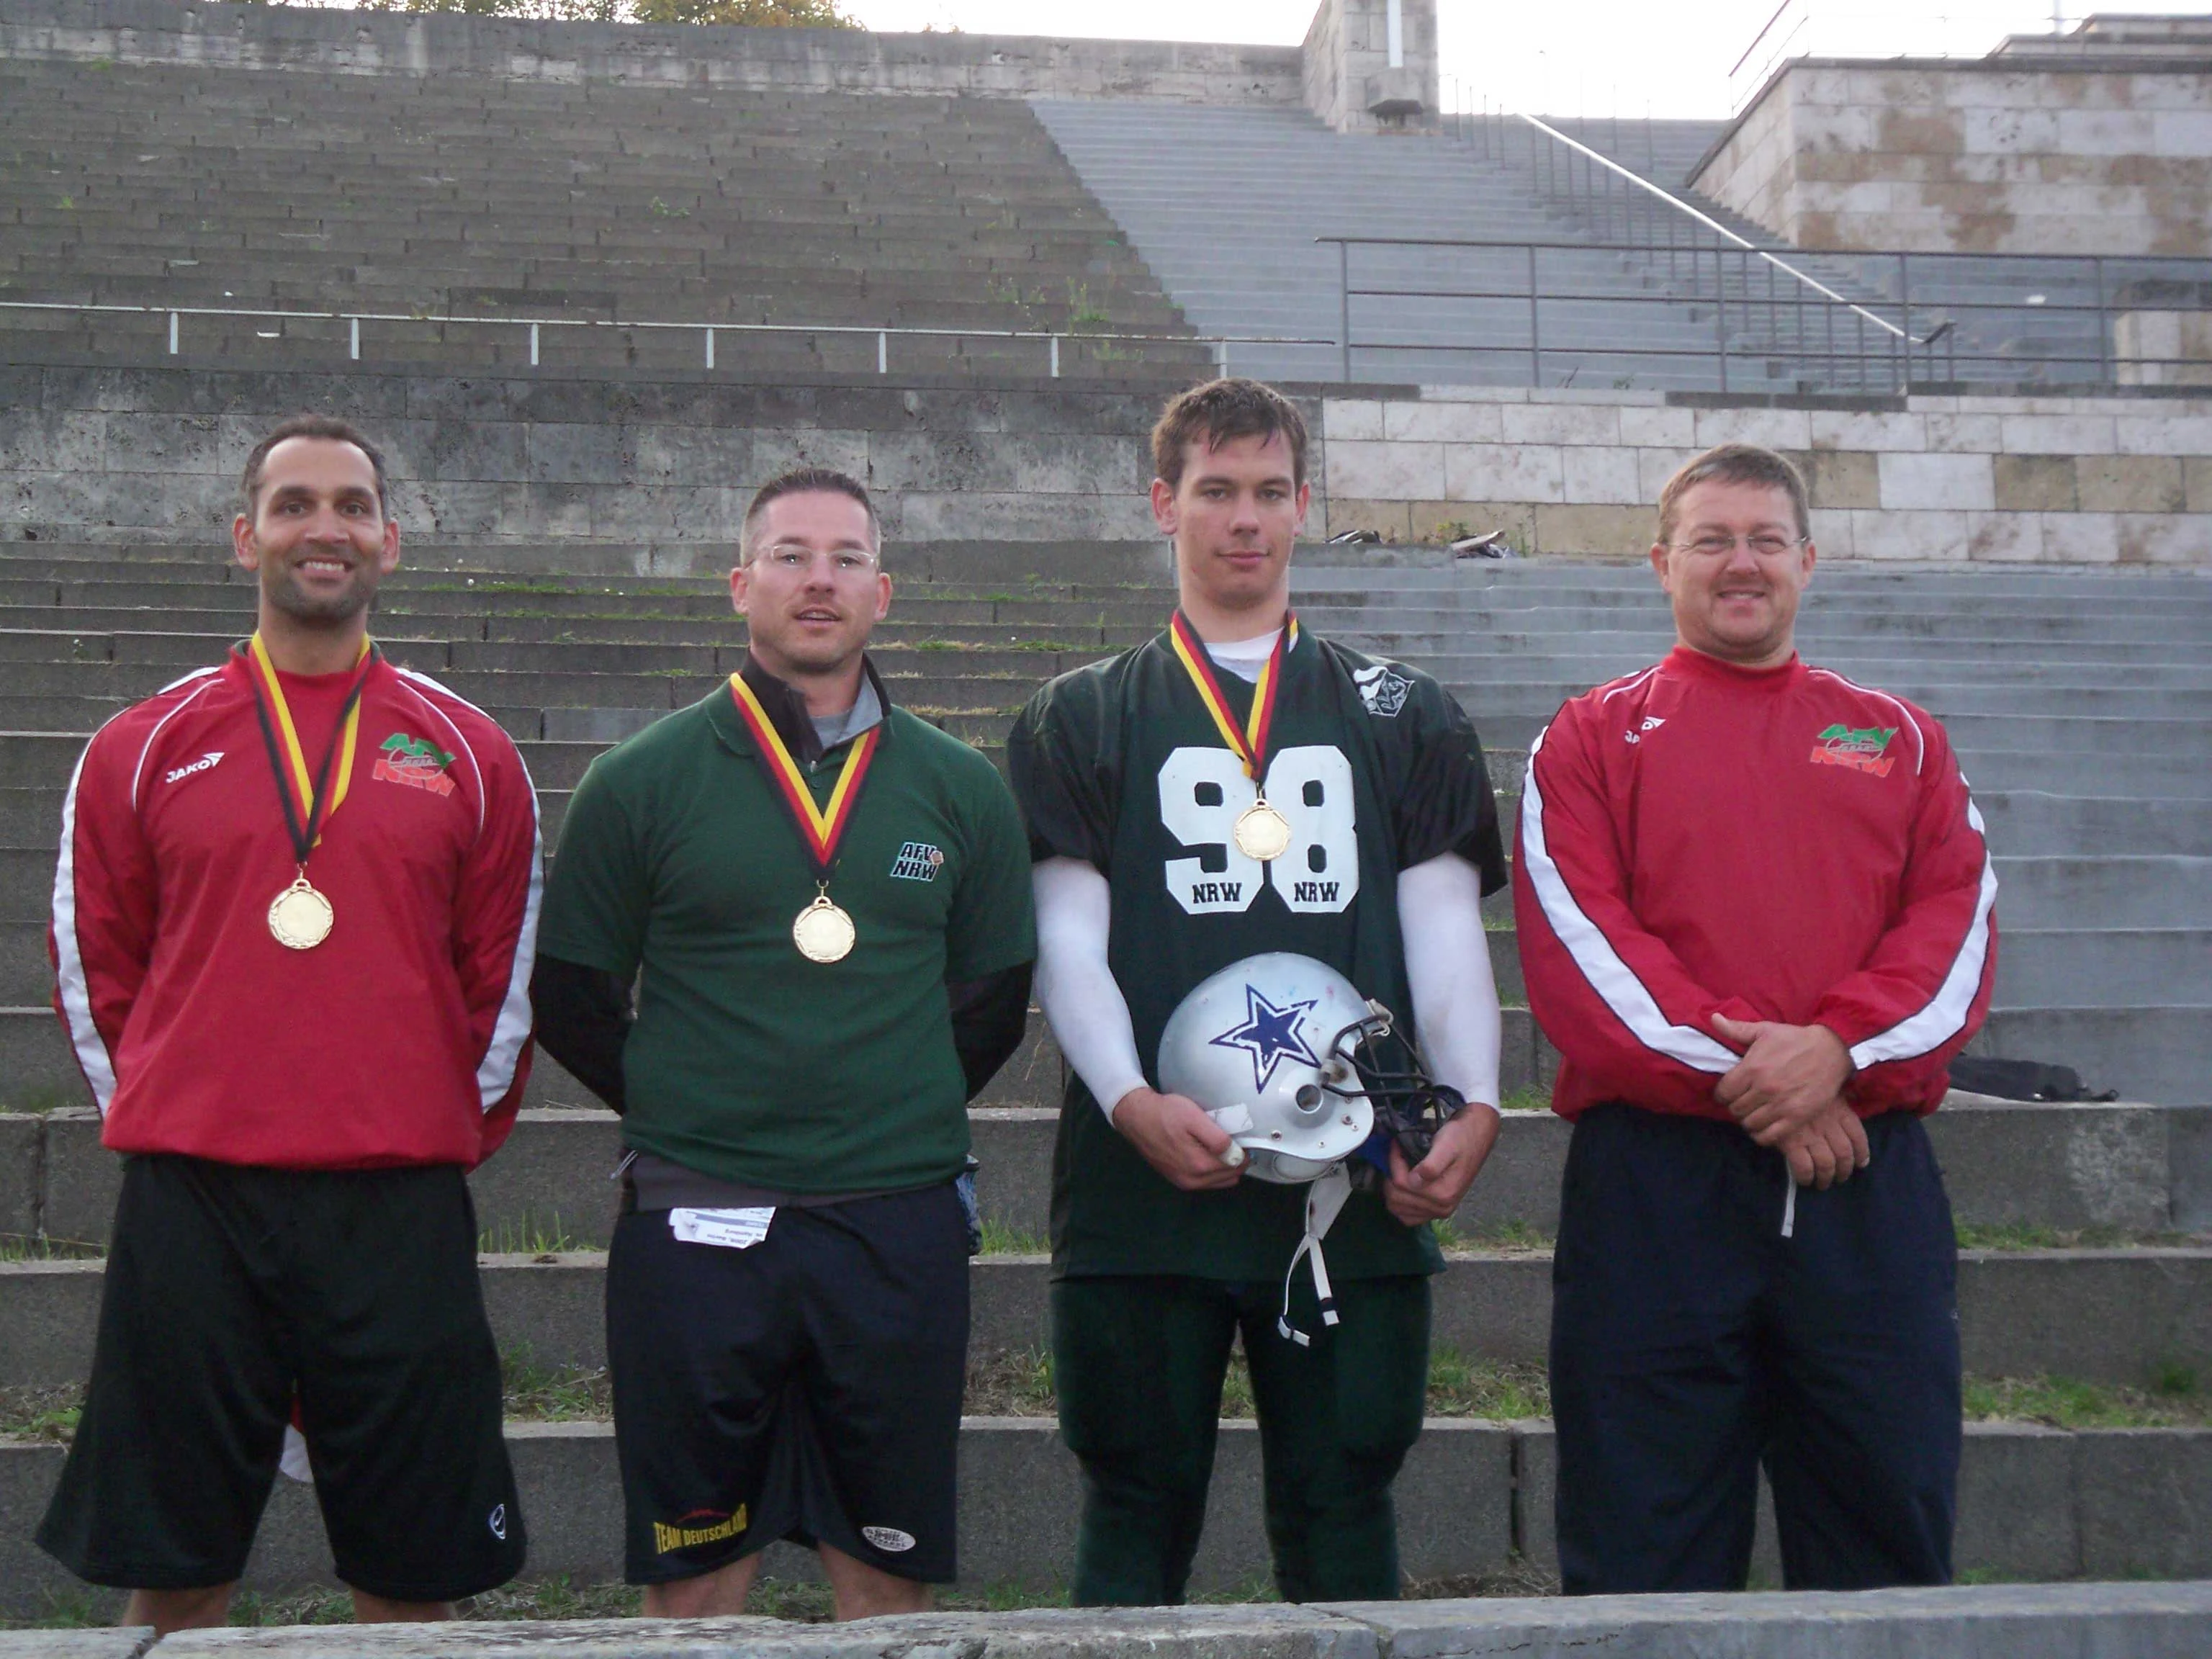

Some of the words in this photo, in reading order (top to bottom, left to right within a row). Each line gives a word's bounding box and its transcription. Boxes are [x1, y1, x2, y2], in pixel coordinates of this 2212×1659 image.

[165, 758, 211, 783] JAKO
[1157, 745, 1360, 914] 98
[898, 842, 937, 862] AFV
[890, 858, 939, 882] NRW
[1192, 882, 1242, 904] NRW
[1294, 881, 1340, 902] NRW
[653, 1521, 682, 1555] TEAM
